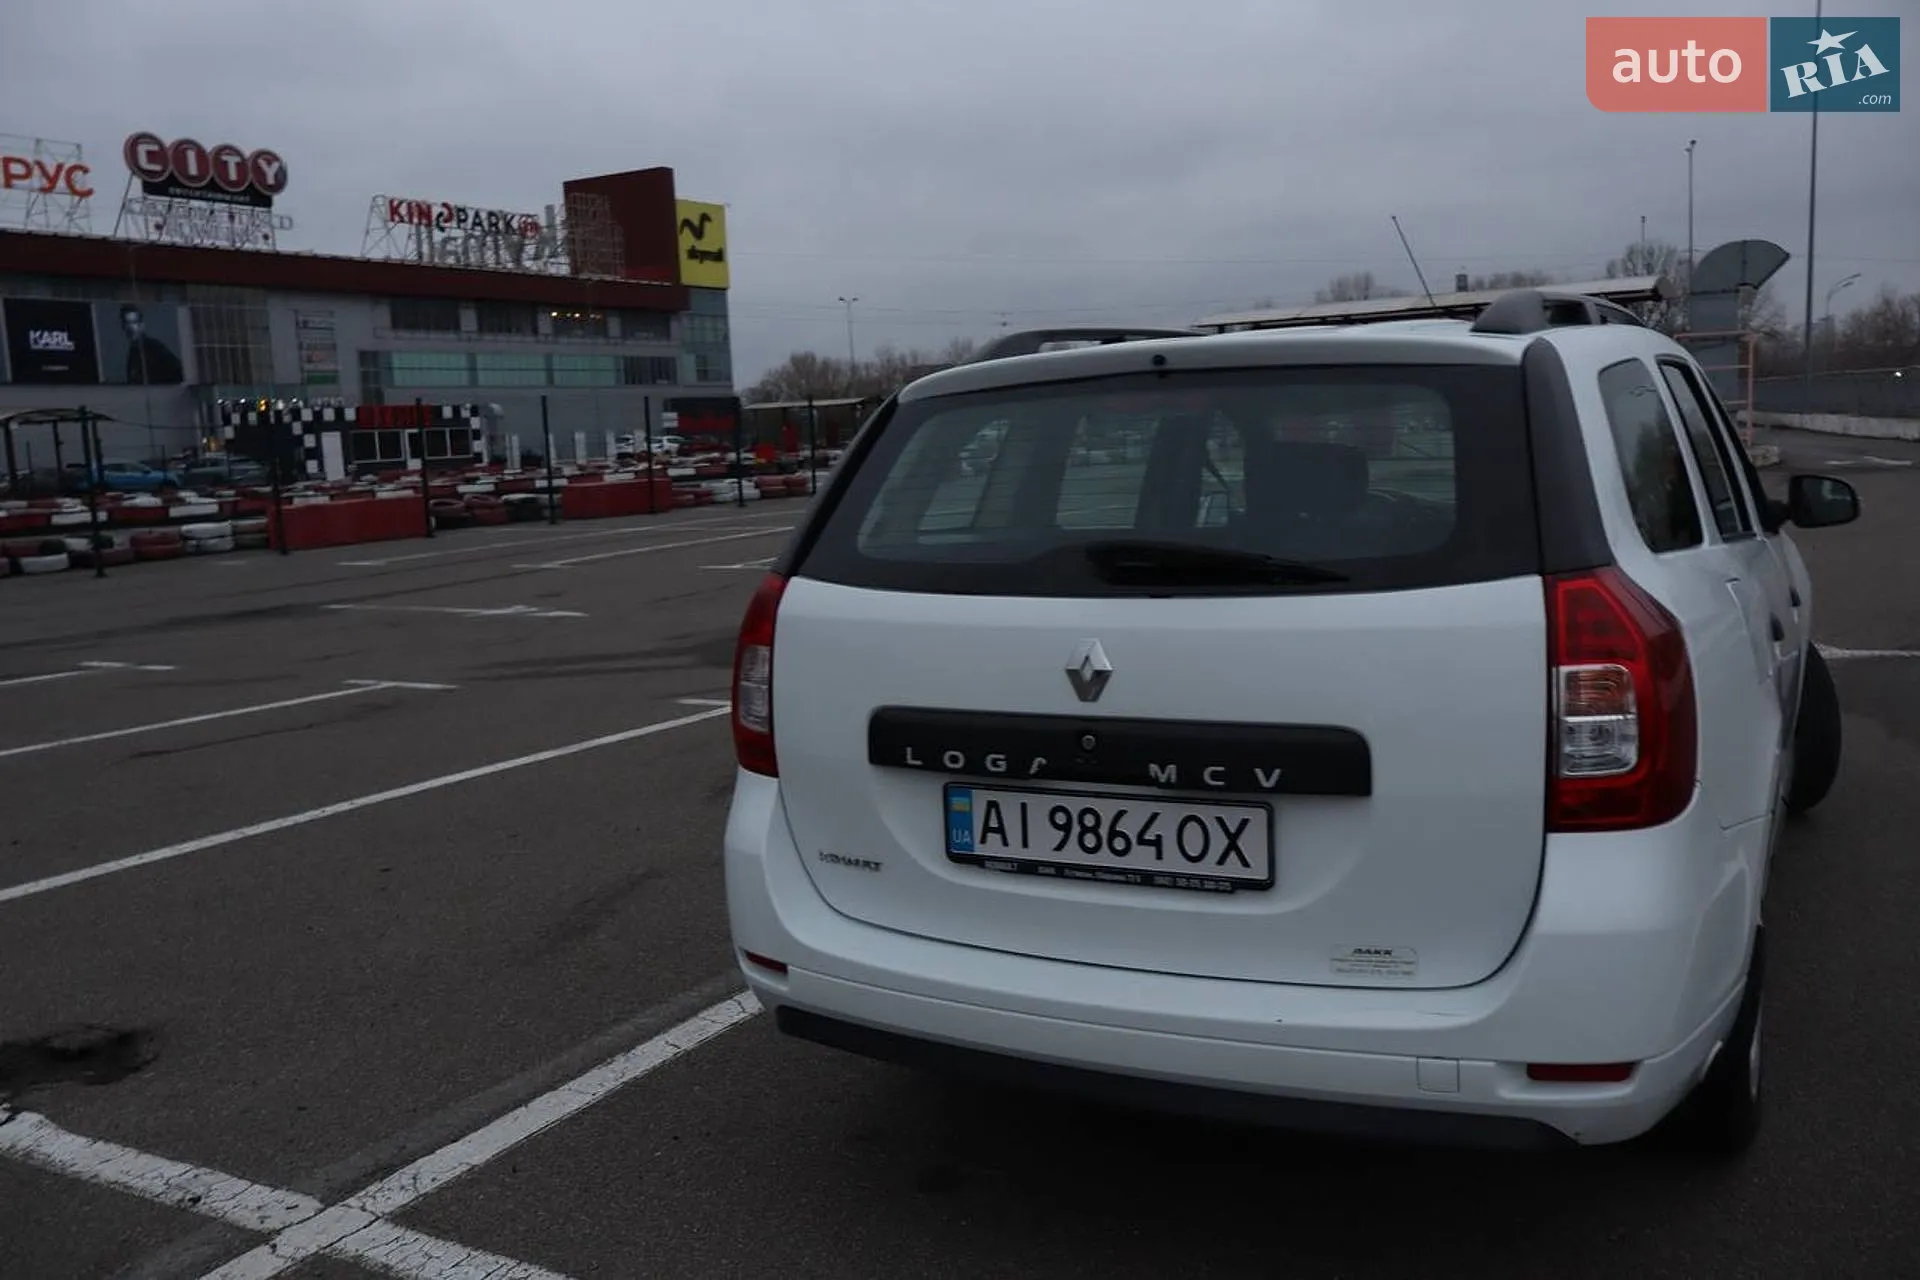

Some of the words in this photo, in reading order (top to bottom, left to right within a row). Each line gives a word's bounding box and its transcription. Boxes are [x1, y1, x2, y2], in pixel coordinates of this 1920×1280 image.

[136, 143, 281, 186] CITY
[28, 329, 74, 346] KARL
[952, 828, 972, 846] UA
[979, 799, 1030, 850] AI
[1049, 805, 1164, 861] 9864
[1176, 814, 1252, 869] OX
